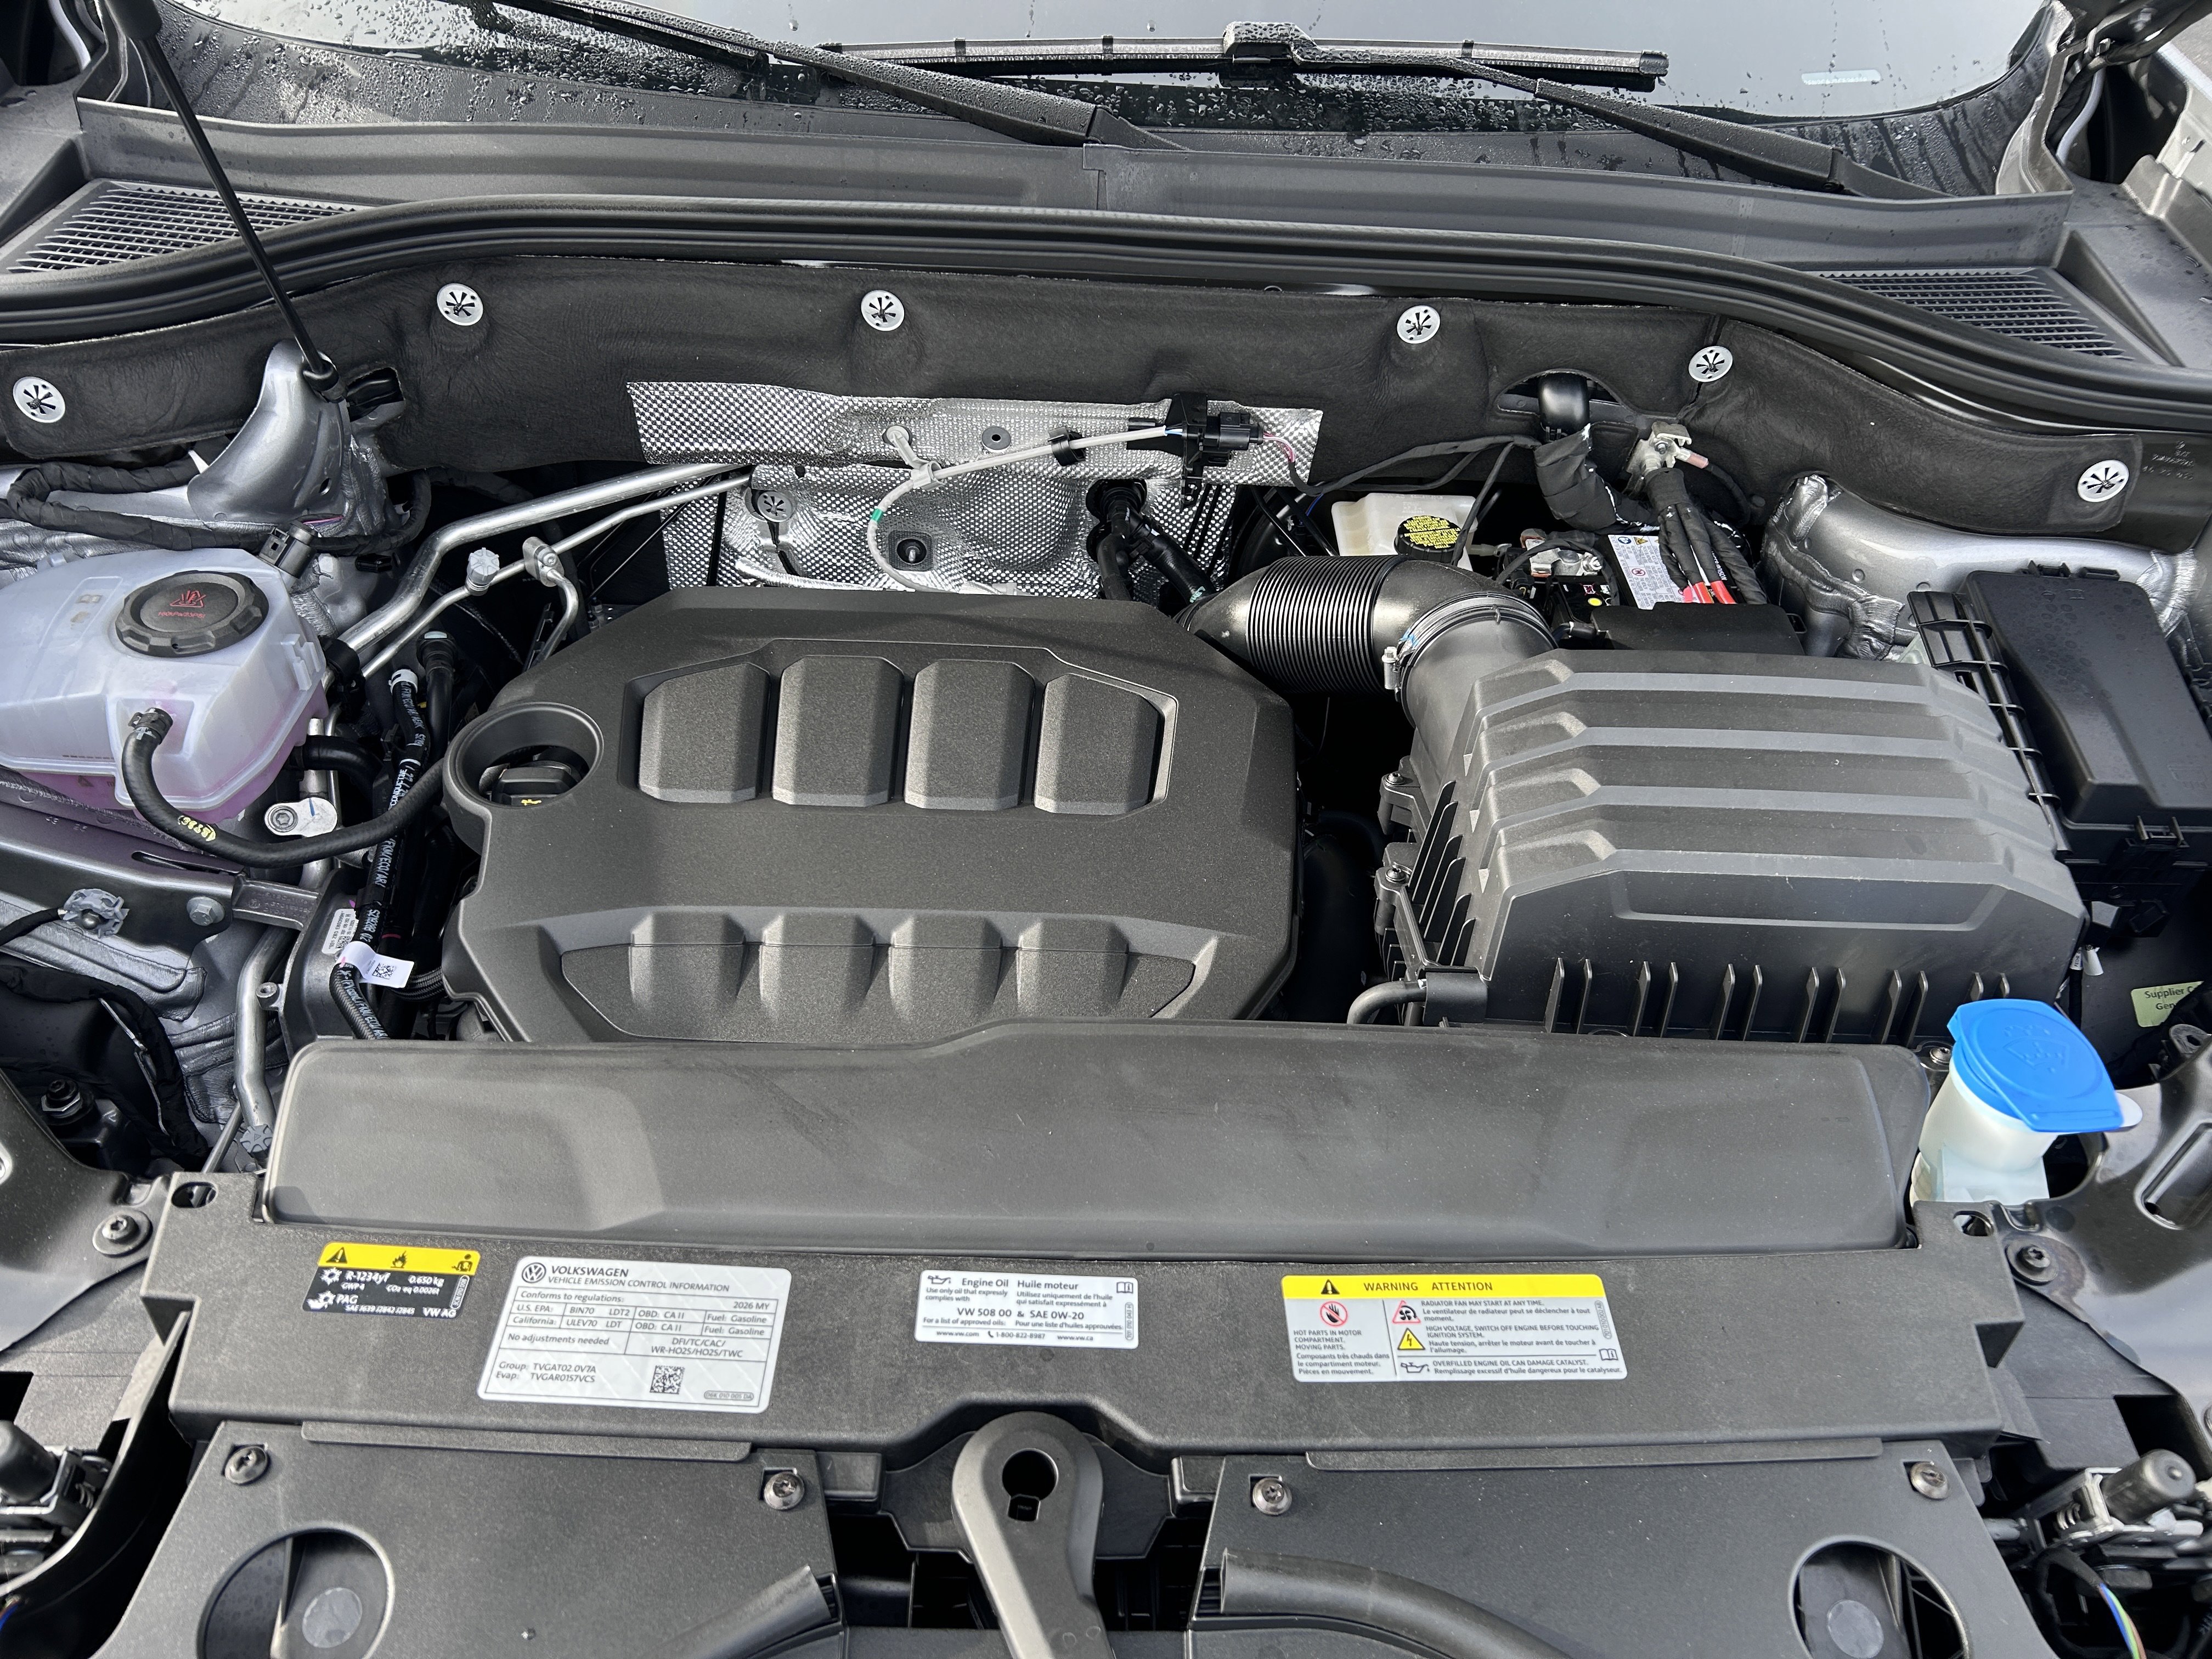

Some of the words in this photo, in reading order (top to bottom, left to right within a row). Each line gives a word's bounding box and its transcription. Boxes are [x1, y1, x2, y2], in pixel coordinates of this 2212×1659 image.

[2144, 988, 2185, 999] Supplier
[551, 1265, 629, 1277] VOLKSWAGEN
[345, 1270, 391, 1284] R-1234yf
[408, 1275, 433, 1284] 0.650
[432, 1276, 444, 1288] kg
[548, 1276, 582, 1284] VEHICLE
[584, 1277, 626, 1286] EMISSION
[627, 1279, 667, 1289] CONTROL
[669, 1281, 730, 1292] INFORMATION
[961, 1277, 993, 1288] Engine
[995, 1278, 1008, 1287] Oil
[1017, 1279, 1042, 1289] Huile
[1043, 1281, 1079, 1290] moteur
[1363, 1282, 1418, 1291] WARNING
[1431, 1282, 1493, 1291] ATTENTION
[520, 1290, 561, 1300] Conforms
[938, 1287, 953, 1295] only
[978, 1289, 1008, 1297] expressly
[336, 1294, 358, 1304] PAG
[569, 1306, 595, 1314] BIN70
[732, 1301, 754, 1310] 2026
[755, 1302, 770, 1310] MY
[423, 1307, 441, 1317] VW
[440, 1308, 456, 1318] AG
[608, 1308, 630, 1317] LDT2
[957, 1307, 975, 1316] VW
[977, 1308, 996, 1317] 508
[998, 1308, 1012, 1317] 00
[1029, 1310, 1048, 1319] SAE
[566, 1318, 597, 1327] ULEV70
[730, 1314, 767, 1323] Gasoline
[605, 1320, 623, 1328] LDT
[727, 1326, 765, 1336] Gasoline
[507, 1333, 521, 1341] No
[521, 1333, 575, 1344] adjustments
[577, 1336, 610, 1345] needed
[1296, 1352, 1336, 1361] Composants
[1434, 1367, 1476, 1375] Remplissage
[1527, 1367, 1562, 1375] dangereux
